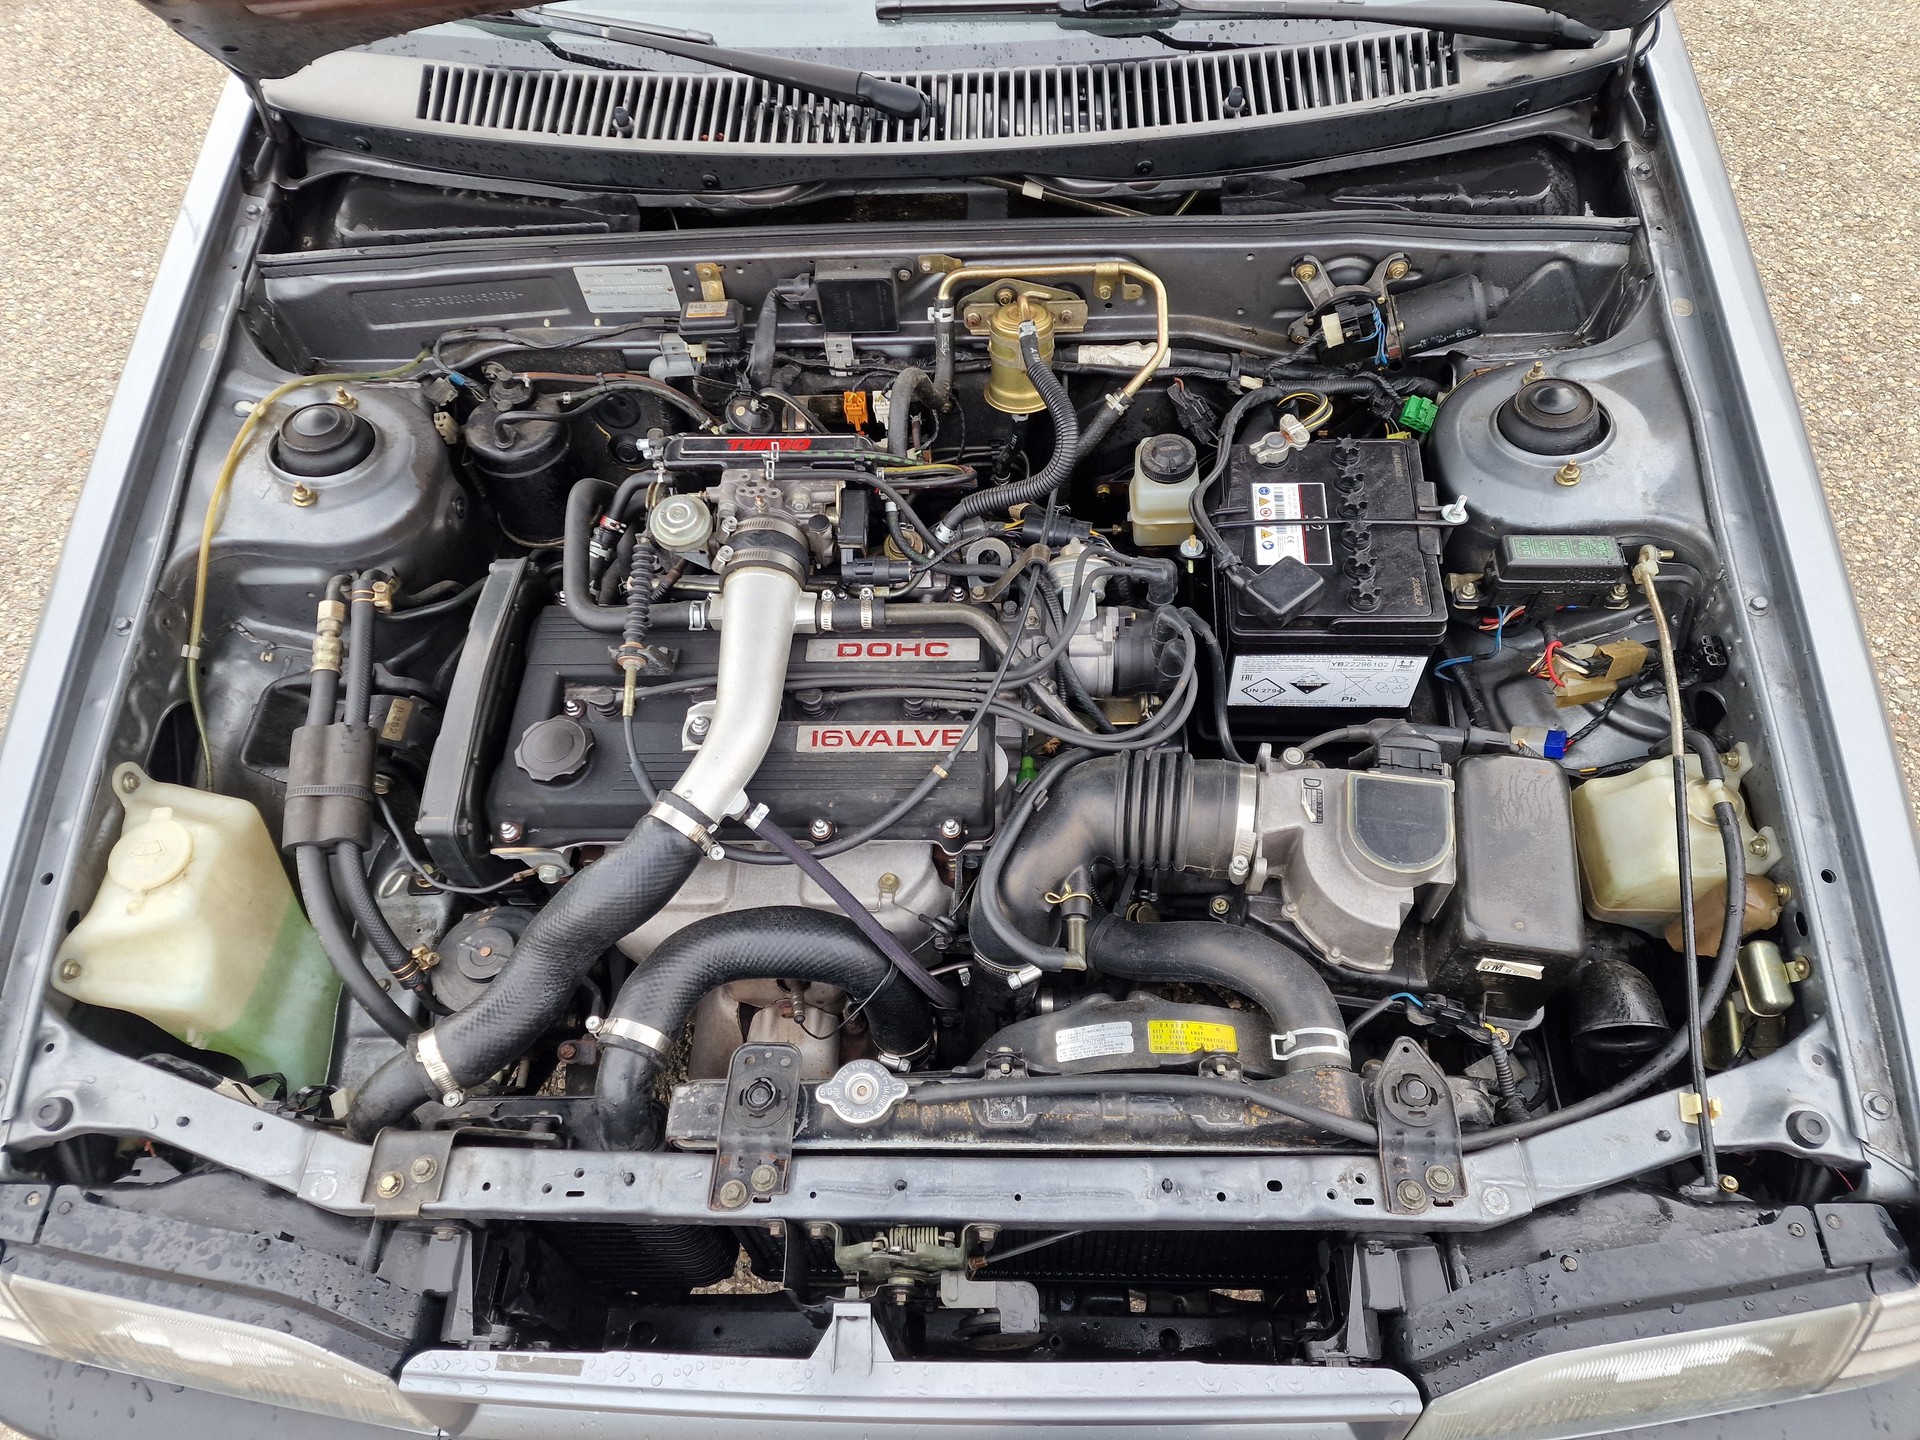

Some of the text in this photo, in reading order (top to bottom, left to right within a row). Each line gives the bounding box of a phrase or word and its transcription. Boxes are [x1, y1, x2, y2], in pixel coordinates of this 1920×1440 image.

[725, 438, 812, 451] TURBO
[837, 642, 949, 657] DOHC
[811, 729, 964, 747] 16VALVE
[852, 1108, 875, 1119] NEVER
